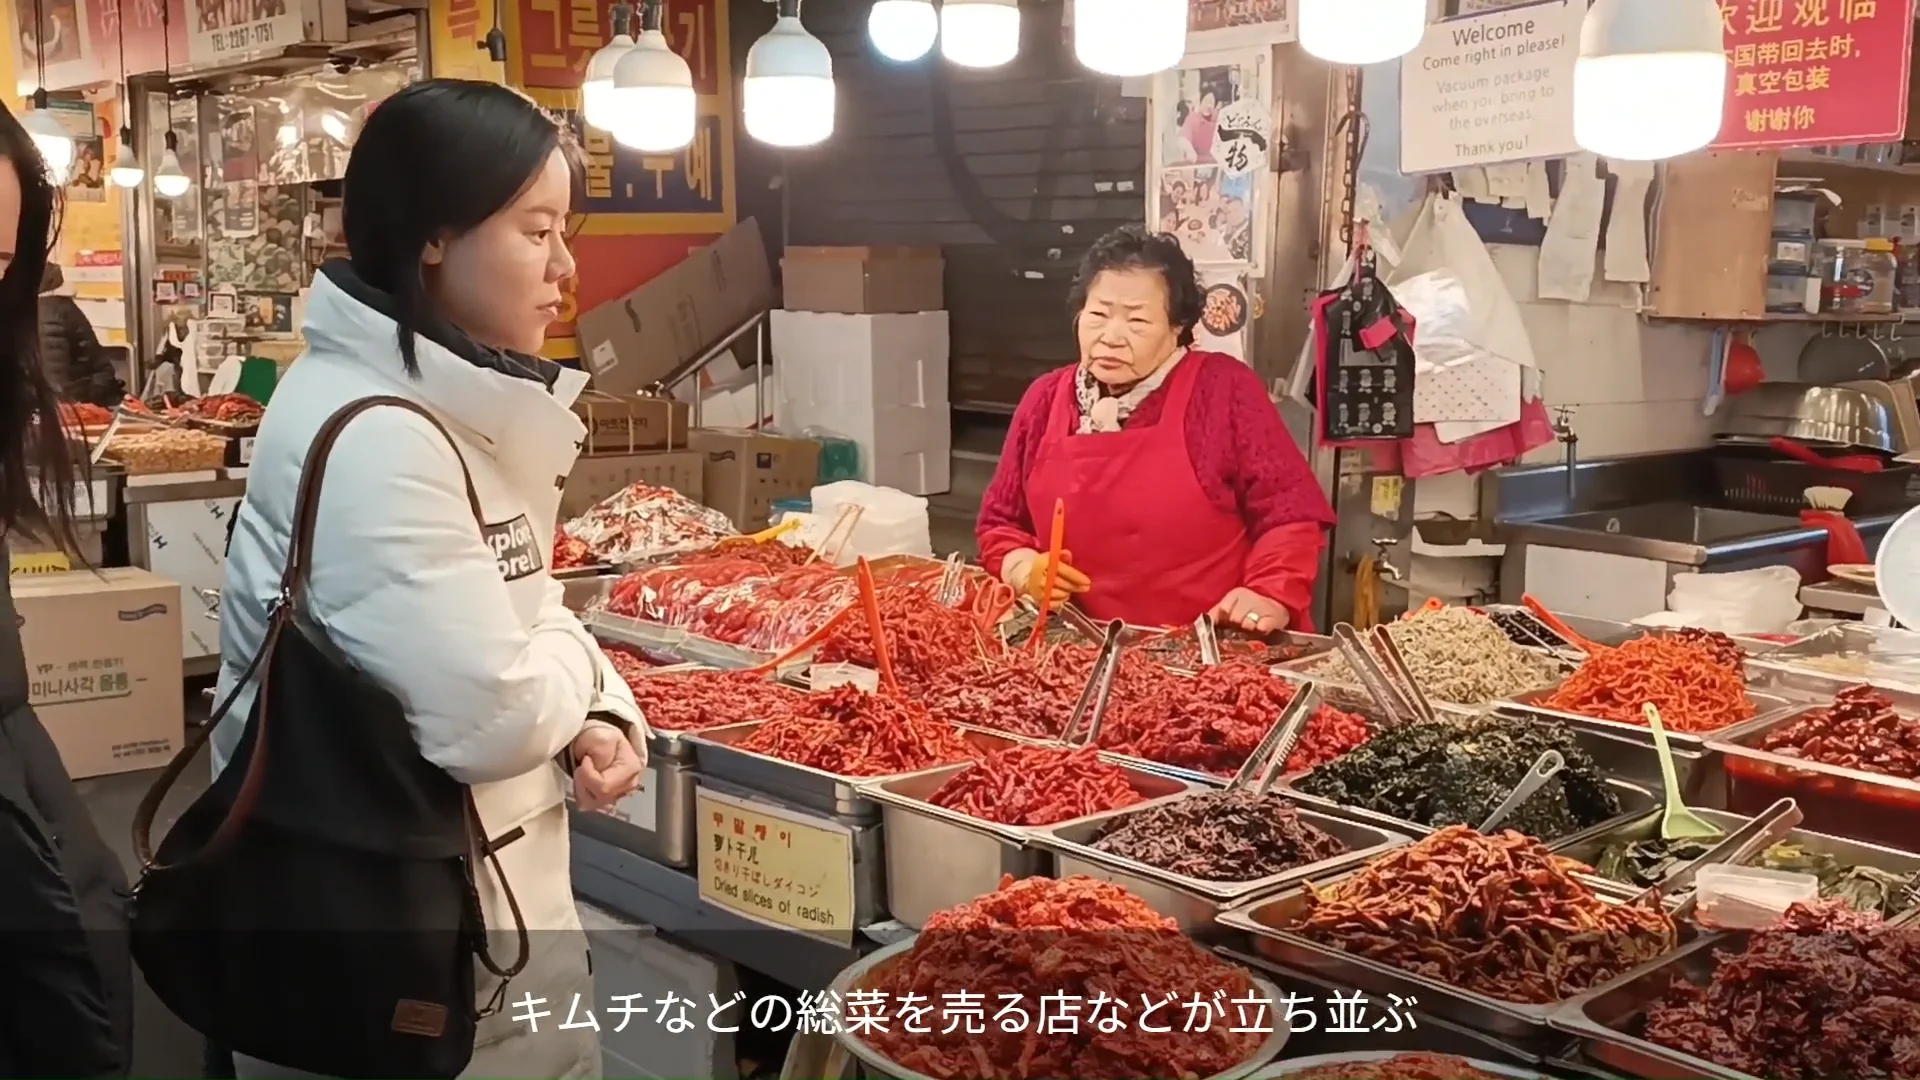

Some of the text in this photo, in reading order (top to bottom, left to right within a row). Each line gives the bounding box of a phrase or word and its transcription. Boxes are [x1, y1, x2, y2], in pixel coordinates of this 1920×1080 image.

[1452, 19, 1535, 47] Welcome
[1423, 33, 1566, 71] Come right in please!
[1436, 66, 1551, 95] Vacuum package
[1735, 65, 1831, 96] 真空包装
[1432, 97, 1468, 113] when
[1501, 88, 1536, 106] bring
[1541, 85, 1555, 98] to
[1450, 116, 1471, 131] the
[1744, 105, 1815, 132] 谢谢你
[1455, 134, 1530, 158] Thank you!
[714, 875, 835, 926] Dried slices of radish
